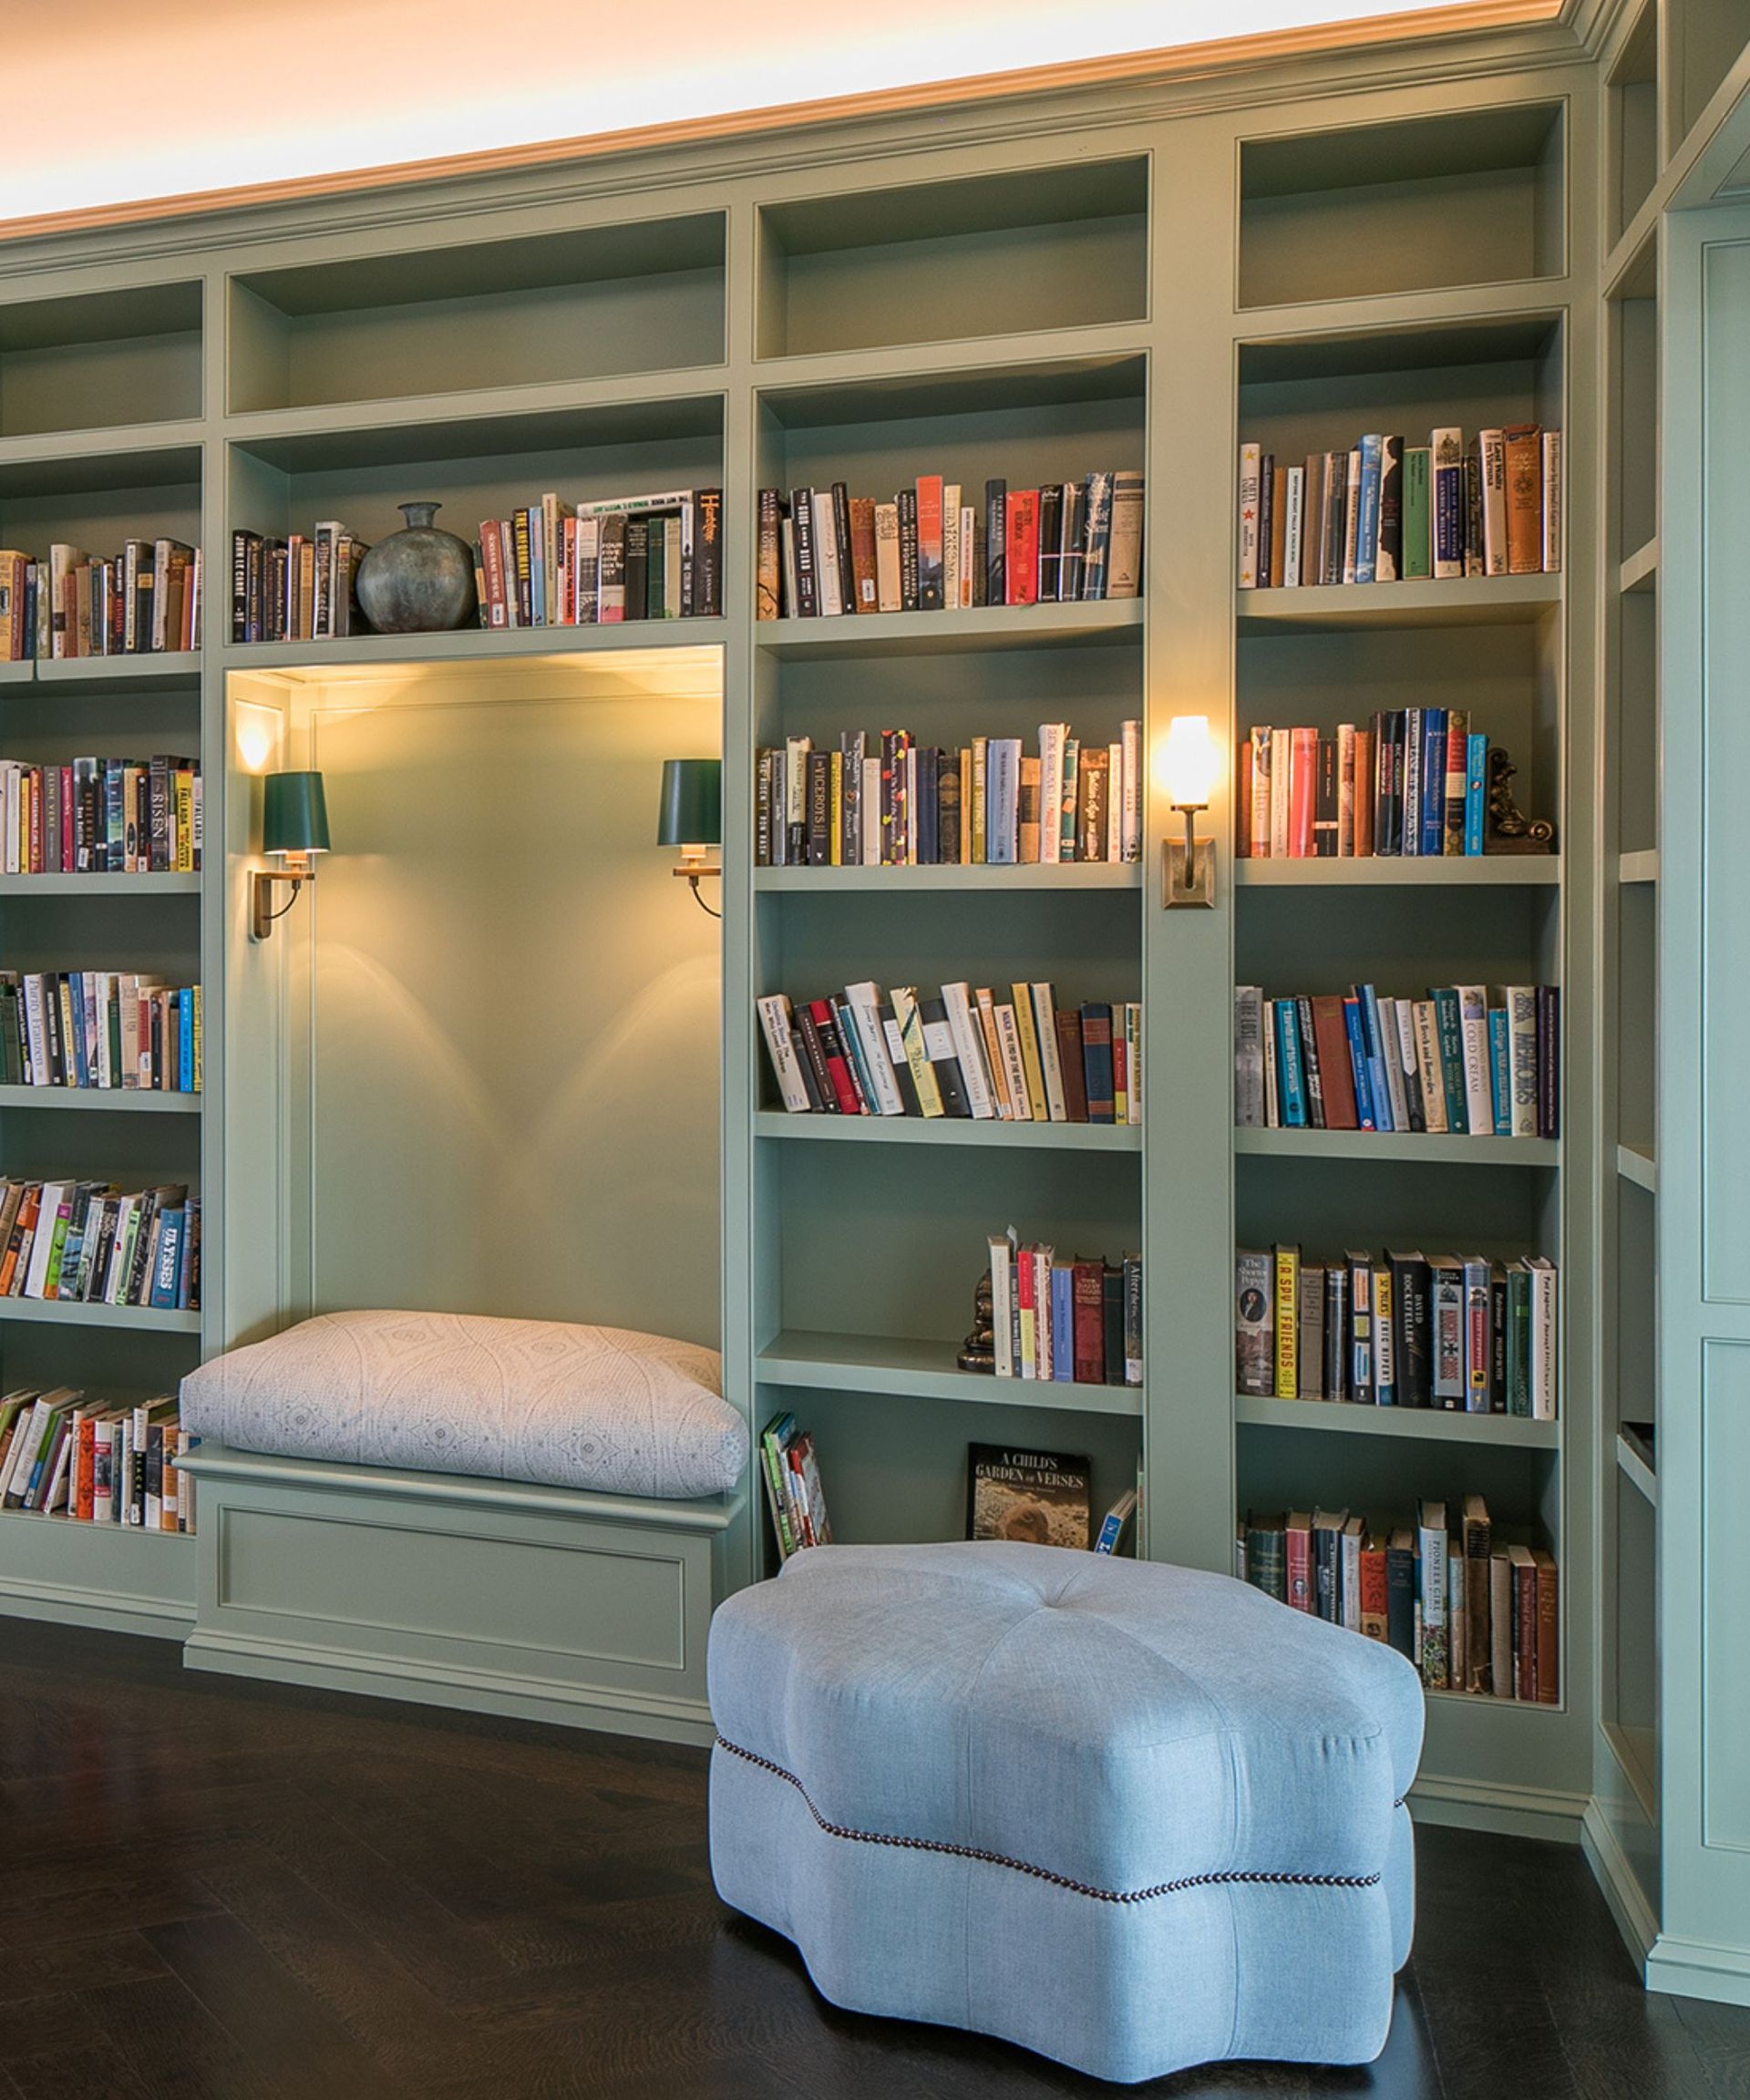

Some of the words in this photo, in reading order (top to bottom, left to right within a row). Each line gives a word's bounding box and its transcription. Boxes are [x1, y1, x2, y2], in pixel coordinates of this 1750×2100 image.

[814, 767, 825, 823] VICEROYS
[152, 793, 165, 838] RISEN
[1466, 1023, 1477, 1053] COLD
[1467, 1056, 1478, 1093] CREAM
[1515, 1032, 1537, 1105] MEMOIRS
[160, 1228, 178, 1290] ULYSSES
[1281, 1279, 1292, 1302] SPY
[1404, 1273, 1414, 1343] ROCKEFELLER
[1415, 1294, 1423, 1323] DAVID
[1281, 1316, 1293, 1368] FRIENDS
[1381, 1321, 1389, 1342] ERIC
[1382, 1348, 1390, 1382] RIPERT
[975, 1464, 1024, 1482] GARDEN
[1036, 1472, 1084, 1488] VERSES
[1001, 1452, 1010, 1465] A
[1012, 1454, 1058, 1470] CHILD'S
[1433, 1540, 1441, 1584] PIONEER
[1434, 1588, 1442, 1611] GIRL
[1523, 1593, 1531, 1613] World
